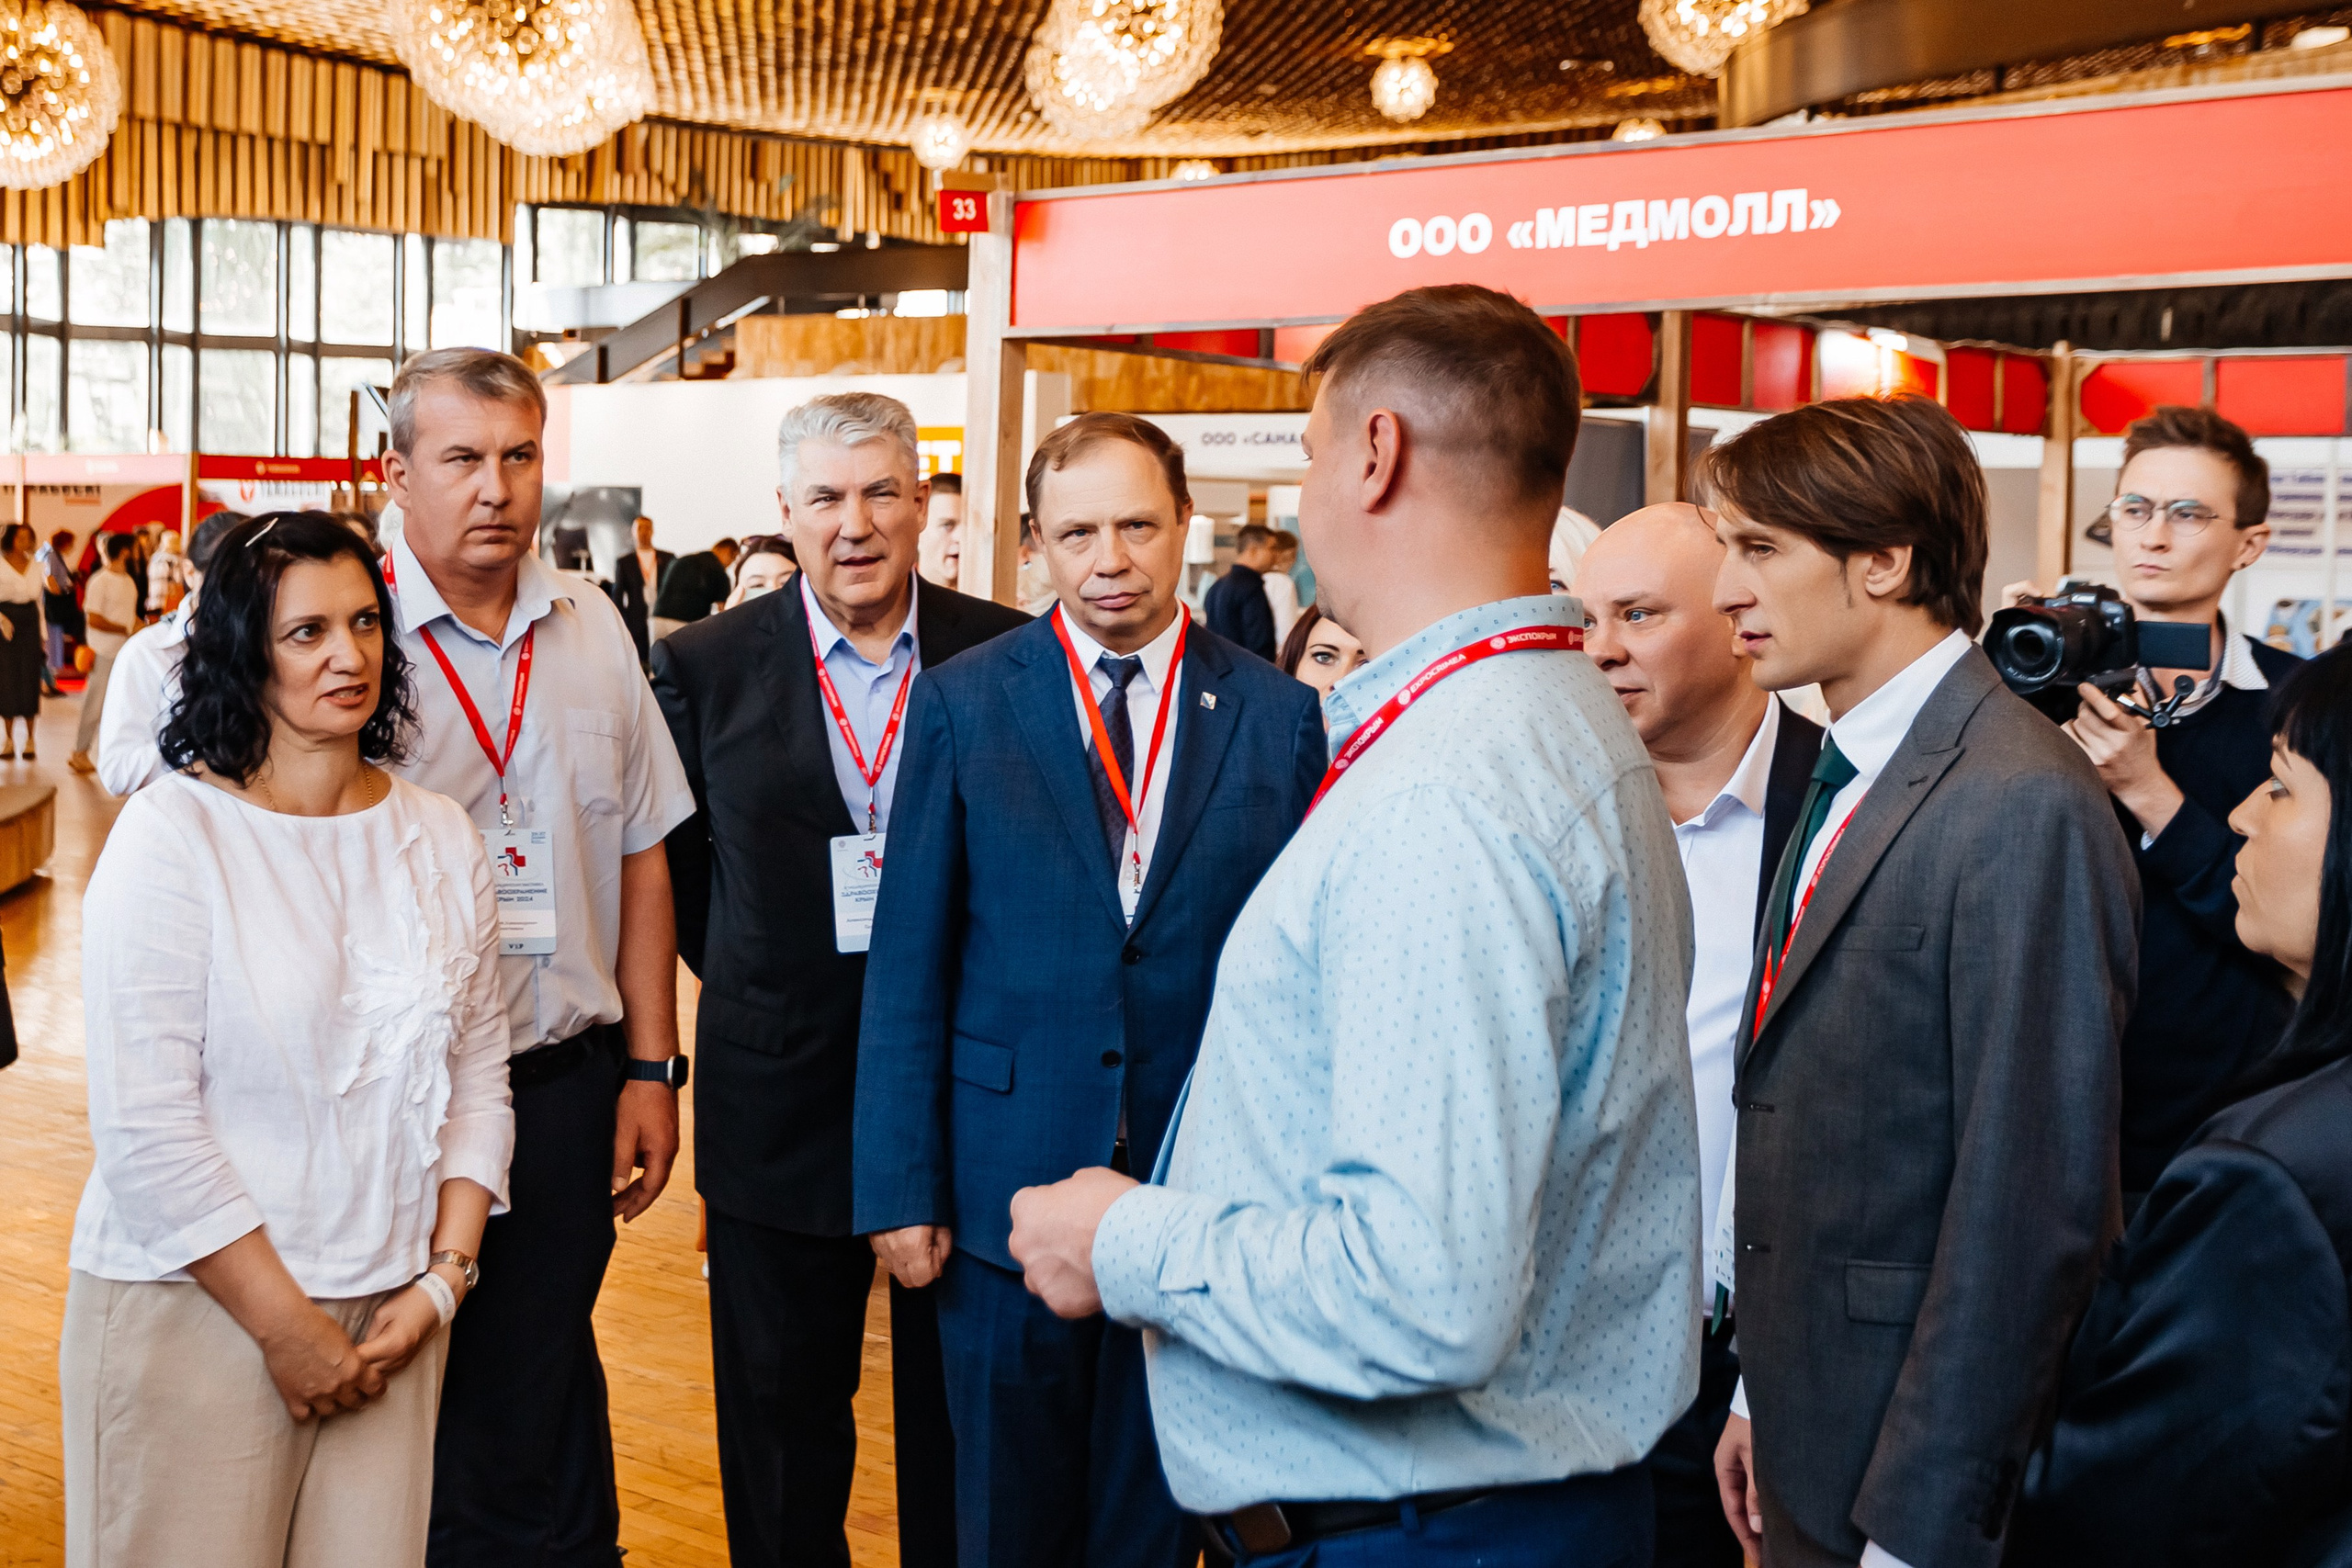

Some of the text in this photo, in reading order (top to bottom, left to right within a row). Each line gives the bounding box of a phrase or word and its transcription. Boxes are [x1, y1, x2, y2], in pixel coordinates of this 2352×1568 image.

[952, 197, 978, 221] 33
[1388, 187, 1842, 259] ООО «МЕДМОЛЛ»
[1202, 432, 1236, 446] ООО
[1507, 631, 1557, 644] ЭКСПОКРЫМ
[1409, 653, 1467, 694] EXPOCRIMEA
[1344, 716, 1385, 759] ЭКСПОКРЫМ
